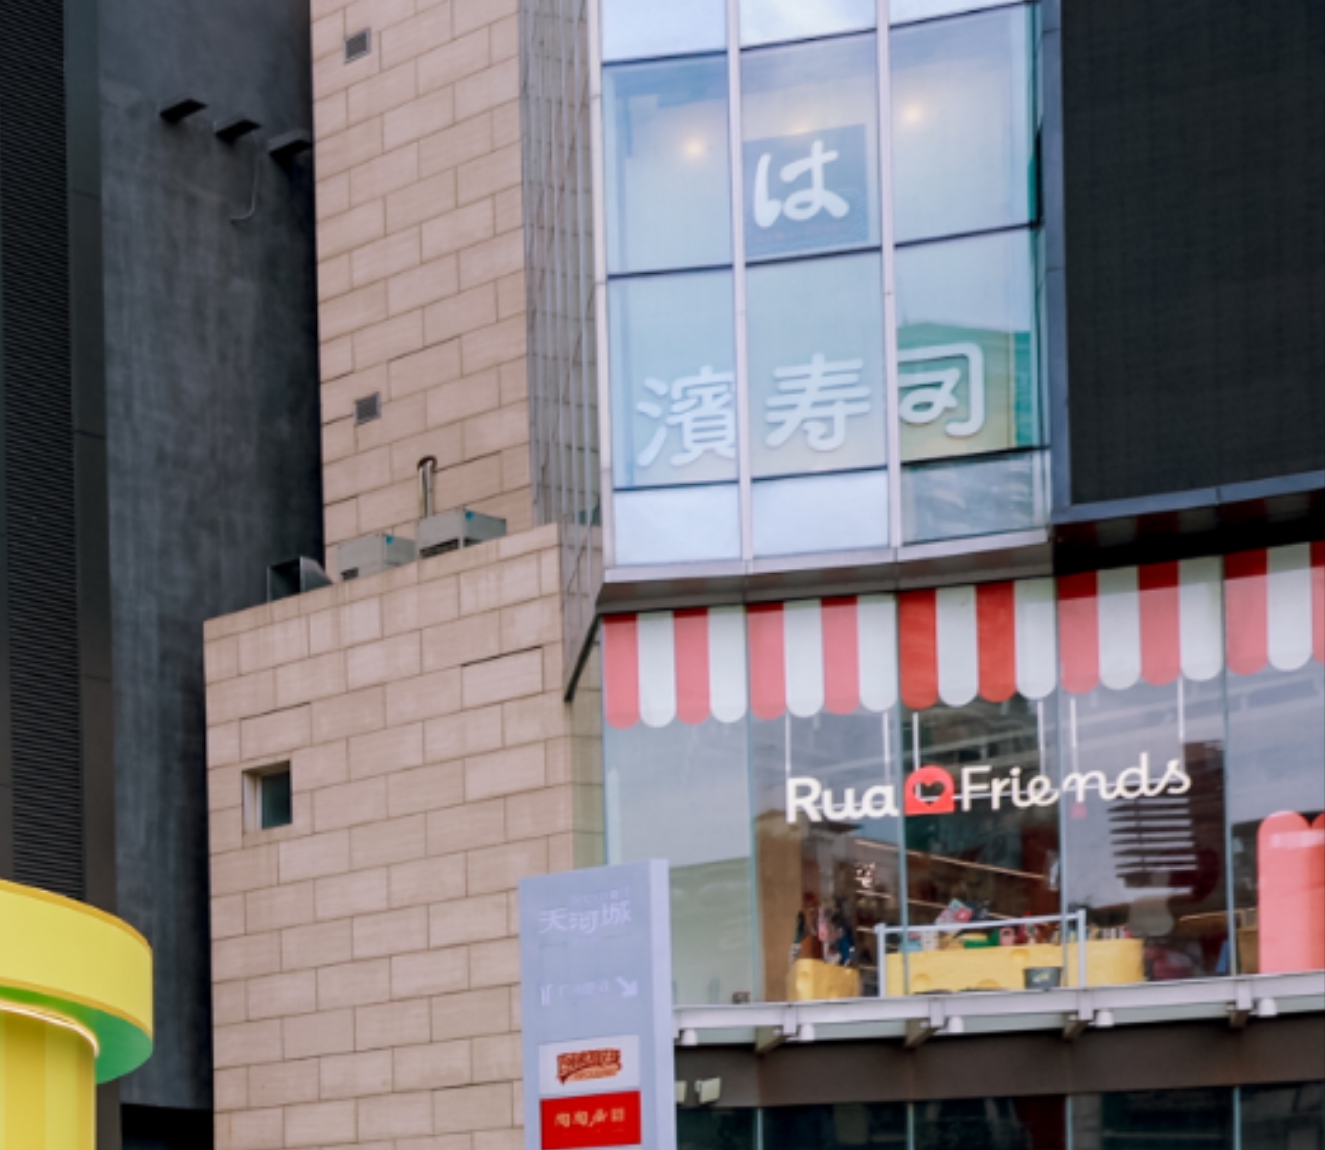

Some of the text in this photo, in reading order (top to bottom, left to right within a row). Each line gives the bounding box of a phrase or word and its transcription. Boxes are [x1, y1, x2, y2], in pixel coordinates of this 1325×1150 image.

[752, 139, 850, 229] は
[785, 752, 1192, 825] Rua Friends
